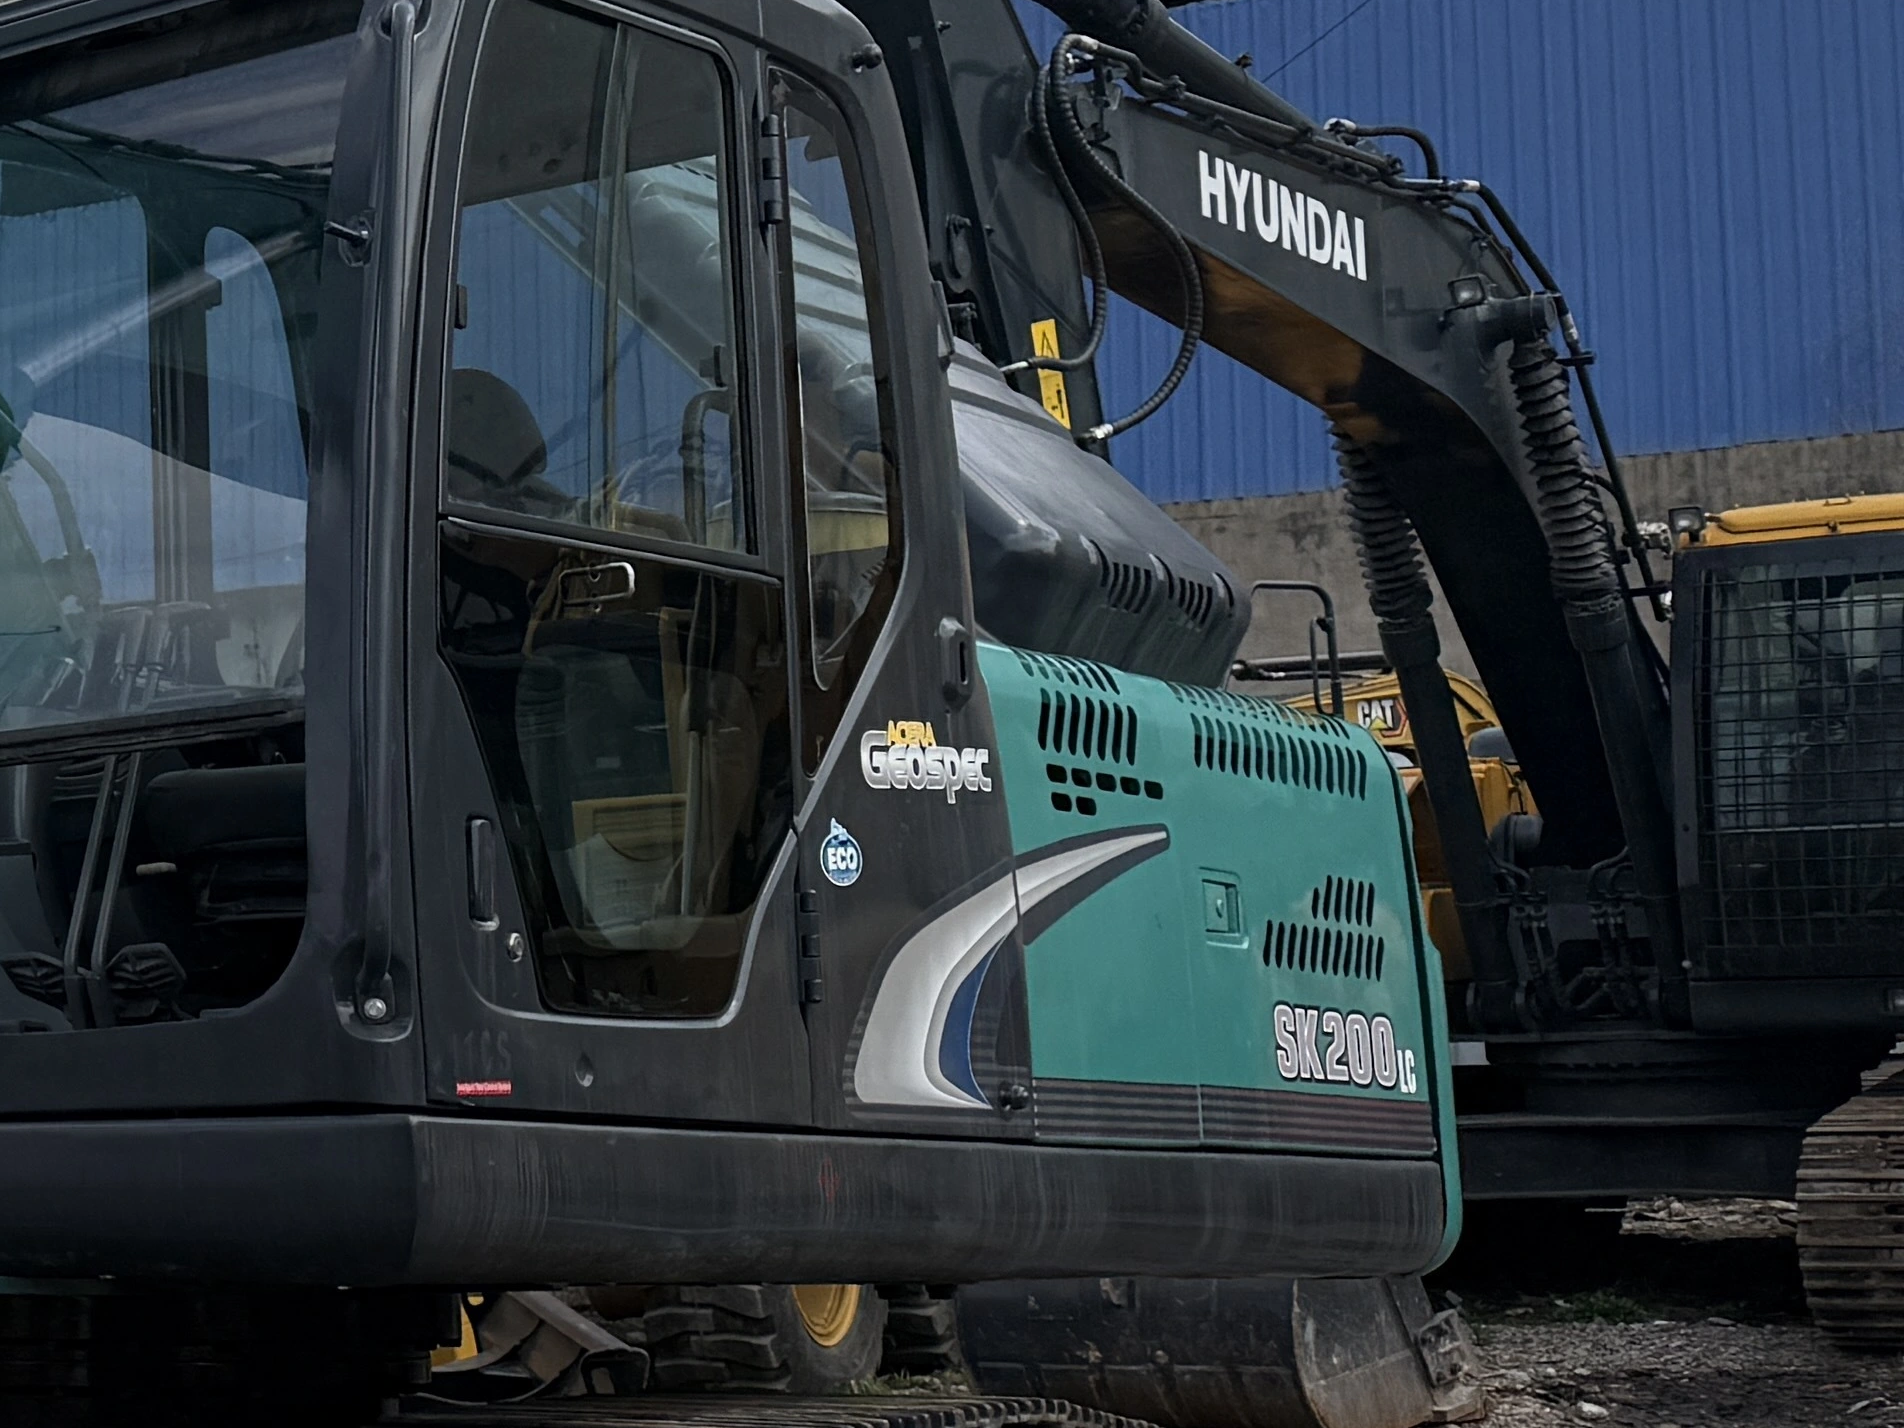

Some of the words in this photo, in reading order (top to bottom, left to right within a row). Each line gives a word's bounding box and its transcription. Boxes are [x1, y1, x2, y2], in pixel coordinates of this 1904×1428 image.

[1198, 149, 1368, 282] HYUNDAI
[1357, 698, 1394, 730] CAT
[827, 846, 858, 872] ECO
